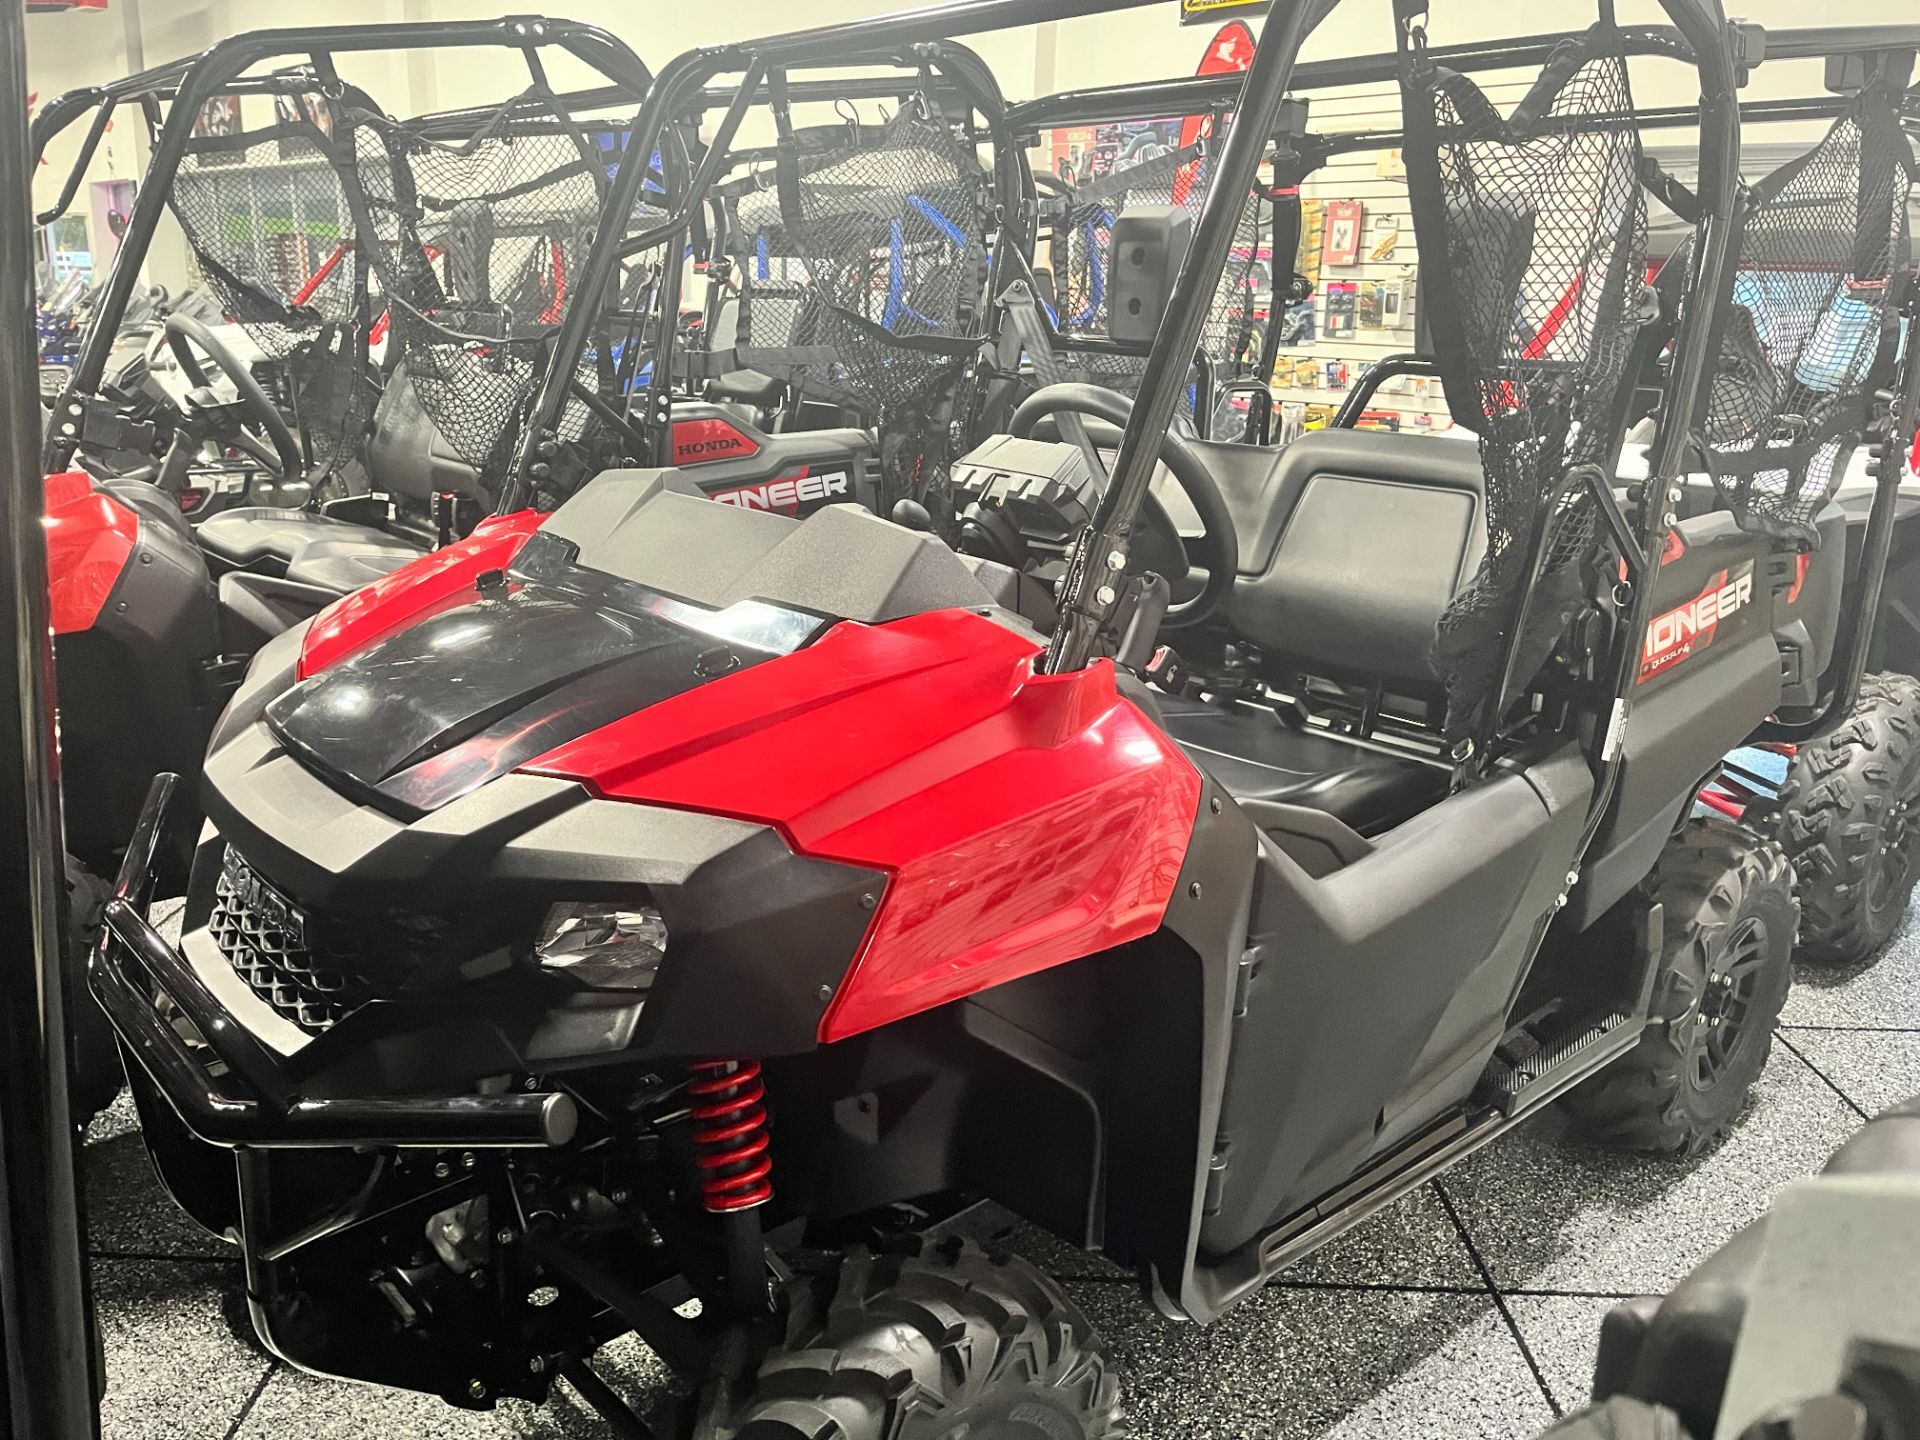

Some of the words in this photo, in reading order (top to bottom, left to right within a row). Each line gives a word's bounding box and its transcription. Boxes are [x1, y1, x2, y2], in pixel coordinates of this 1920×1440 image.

[677, 438, 742, 456] HONDA
[713, 471, 848, 509] ONEER
[1645, 572, 1753, 658] IONEER
